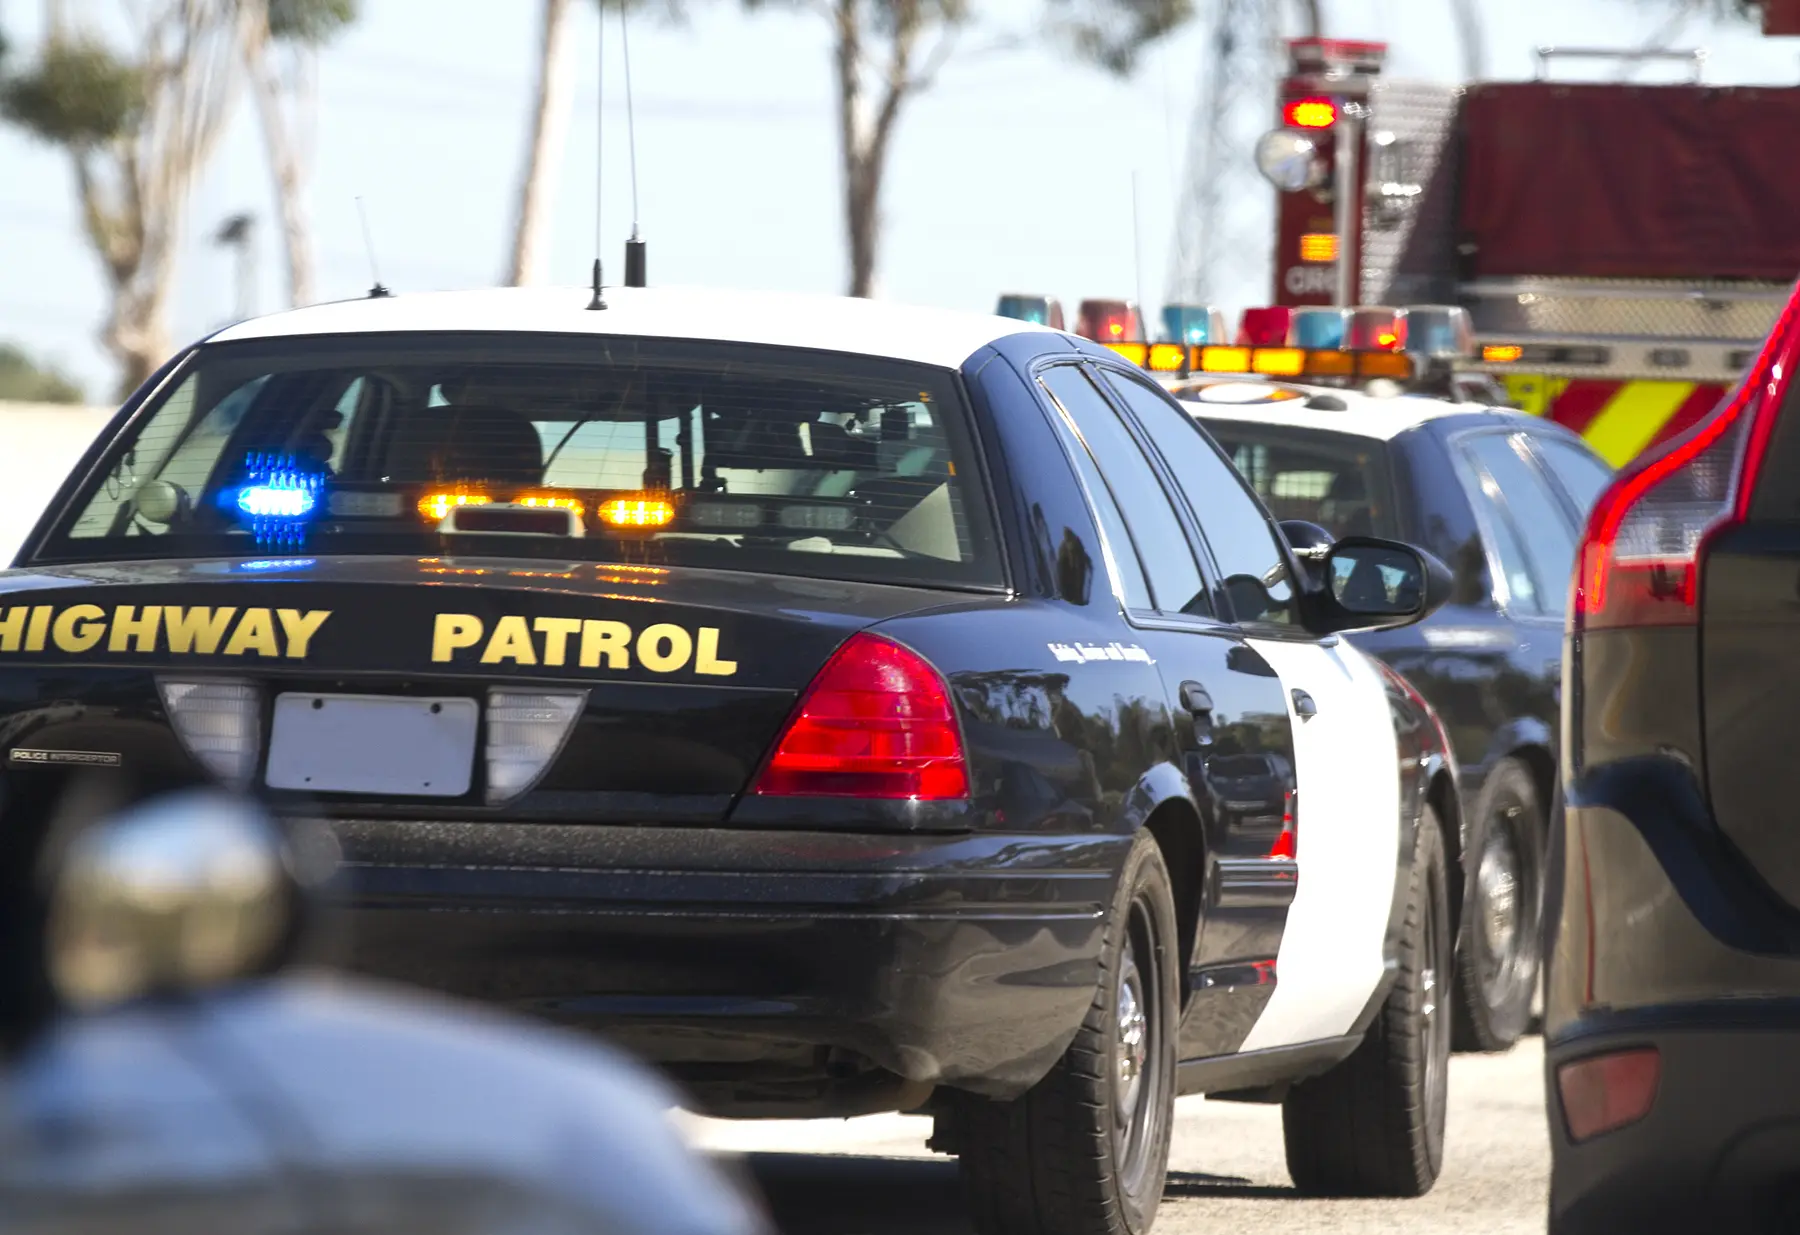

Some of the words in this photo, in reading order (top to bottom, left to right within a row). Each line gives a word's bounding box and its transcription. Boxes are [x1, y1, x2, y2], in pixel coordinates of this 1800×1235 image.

[0, 604, 334, 658] HIGHWAY
[431, 613, 738, 676] PATROL
[13, 751, 48, 760] POLICE
